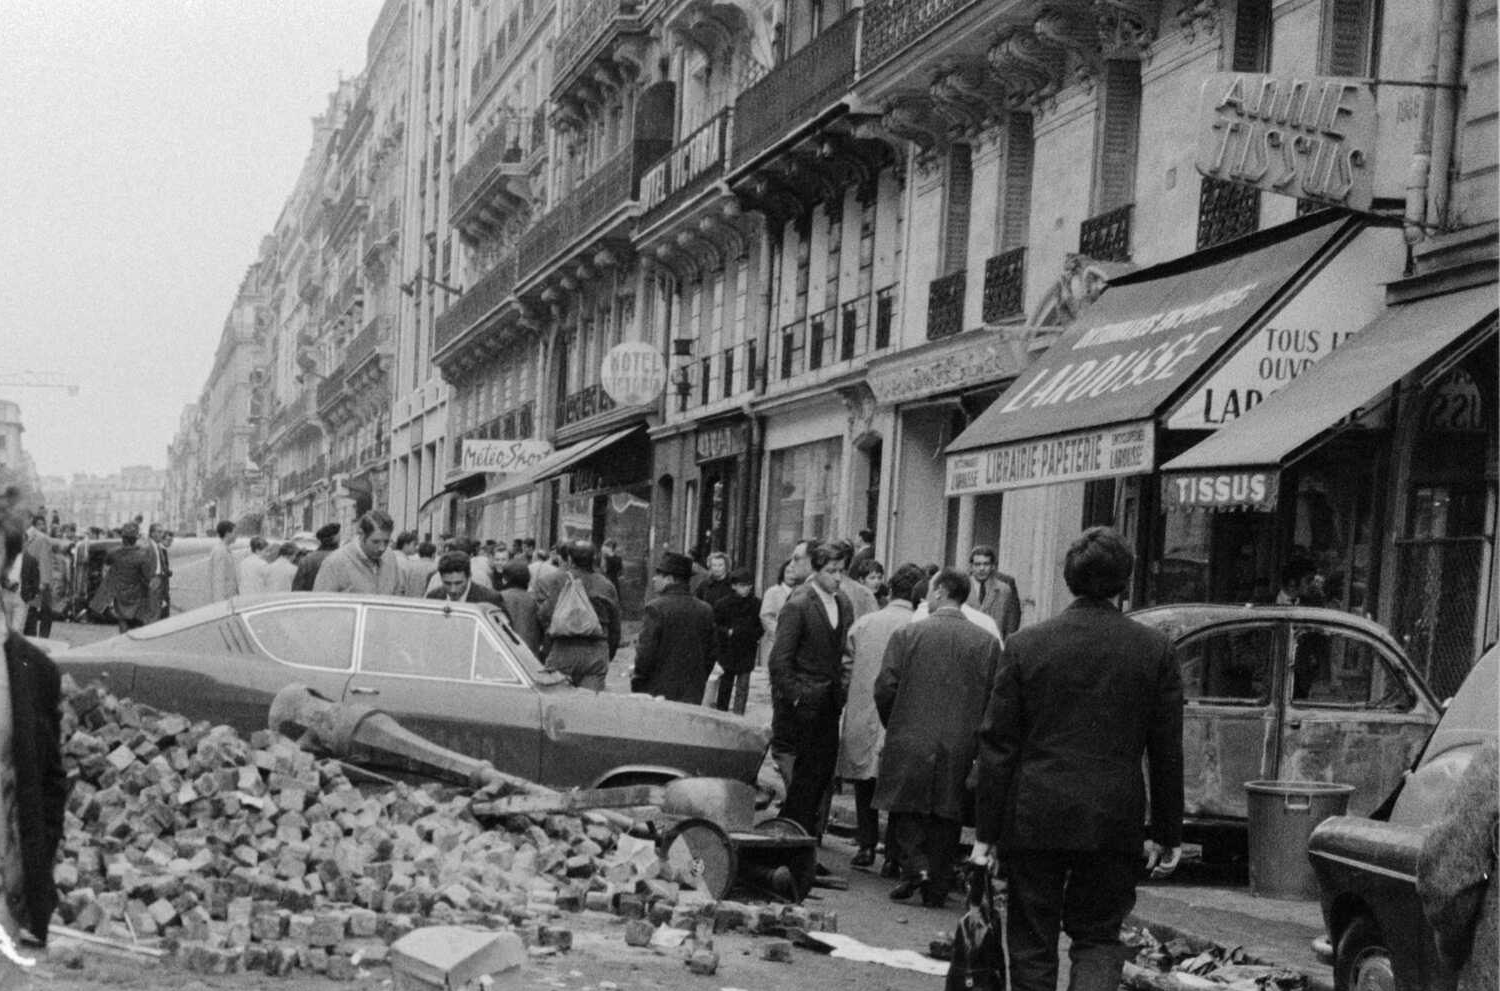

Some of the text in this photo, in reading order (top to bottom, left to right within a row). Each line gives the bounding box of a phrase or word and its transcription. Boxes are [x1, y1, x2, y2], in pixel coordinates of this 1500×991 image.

[1211, 117, 1367, 202] TISSUS
[1266, 328, 1321, 353] TOUS
[1000, 326, 1223, 414] LAROUSSE
[1175, 474, 1266, 504] TISSUS
